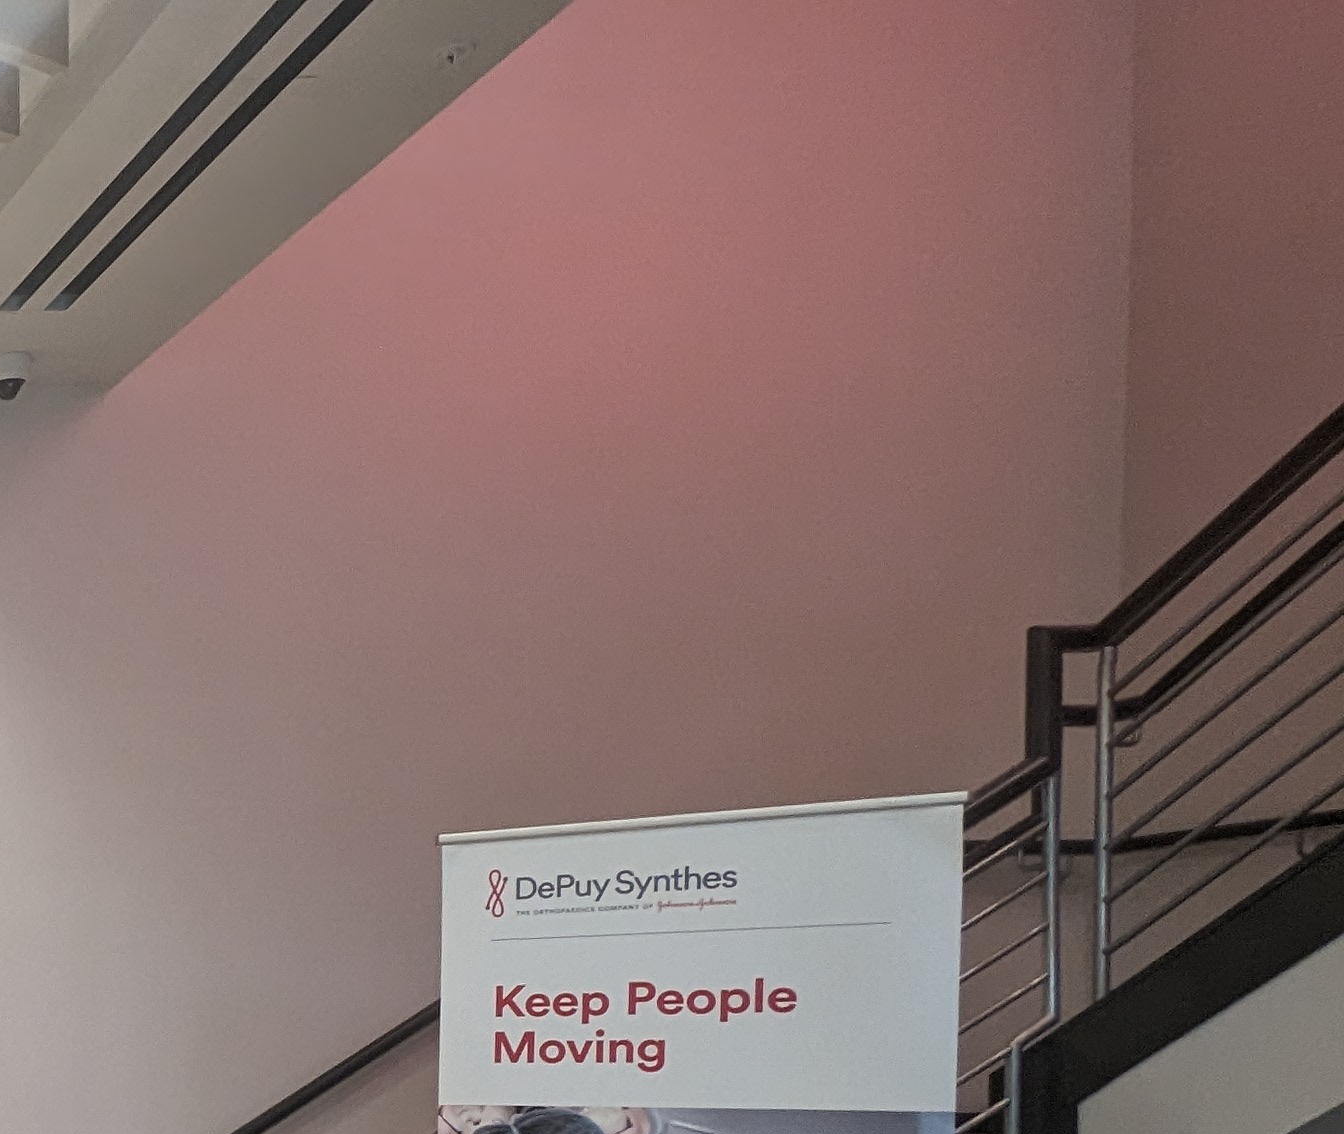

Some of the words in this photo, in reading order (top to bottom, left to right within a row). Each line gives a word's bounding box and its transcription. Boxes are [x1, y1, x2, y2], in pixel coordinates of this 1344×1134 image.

[515, 874, 611, 902] DePuy
[615, 865, 738, 900] Synthes
[494, 984, 610, 1025] Keep
[627, 977, 798, 1023] People
[493, 1029, 666, 1073] Moving
